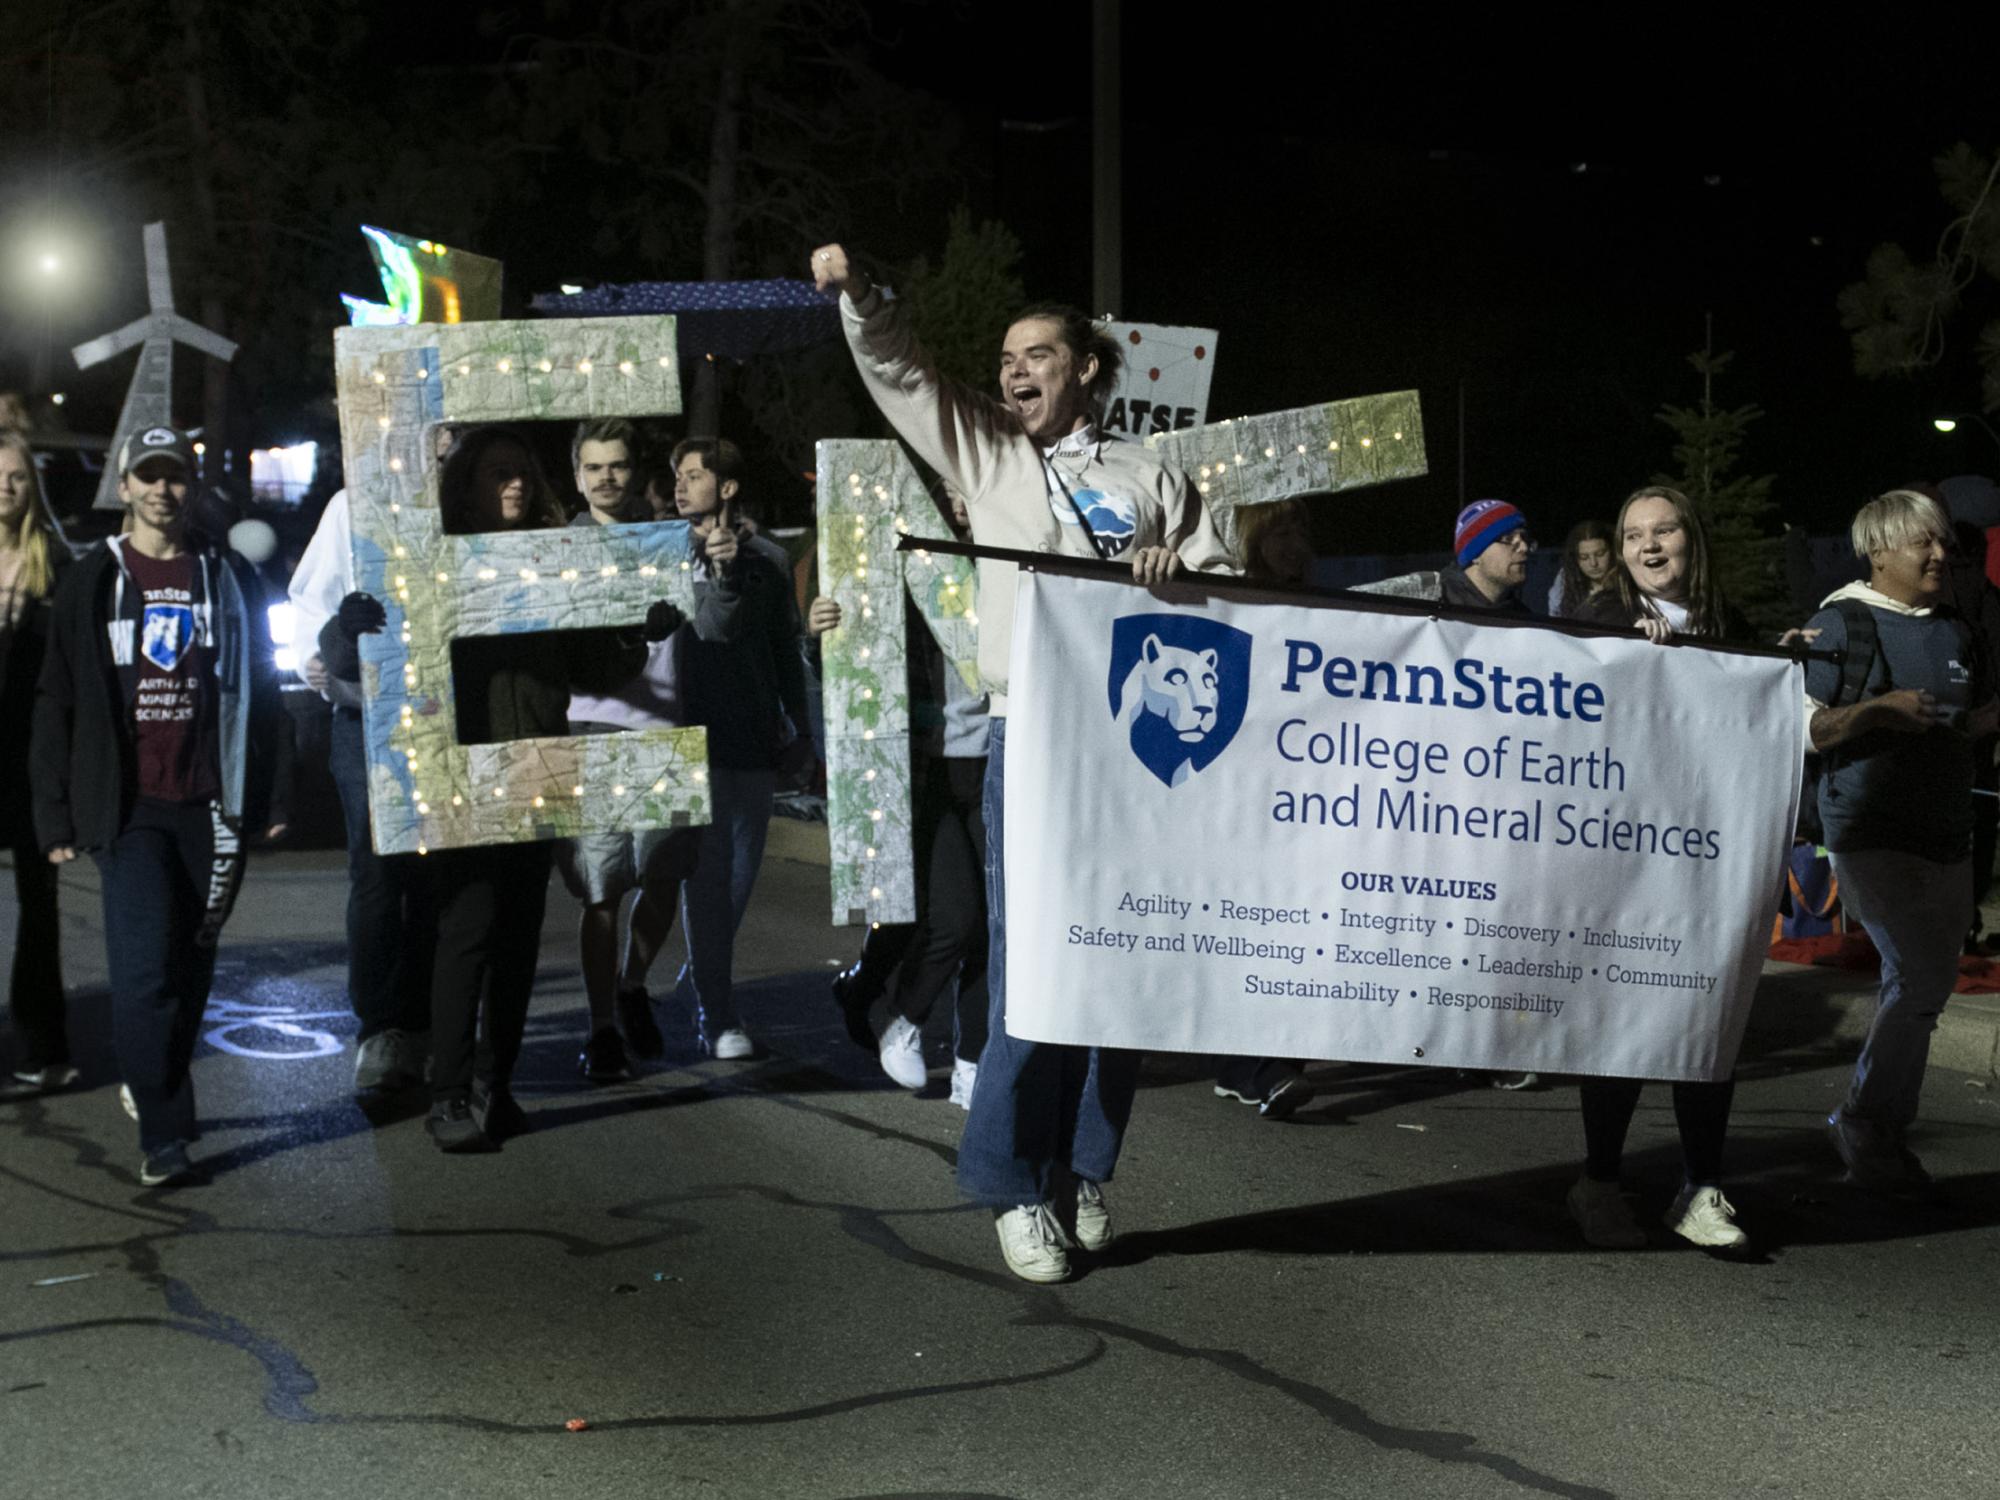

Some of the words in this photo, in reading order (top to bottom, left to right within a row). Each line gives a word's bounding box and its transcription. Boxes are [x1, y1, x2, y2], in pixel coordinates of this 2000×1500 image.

[1280, 639, 1605, 722] PennState
[1276, 718, 1449, 783] College
[1463, 735, 1511, 779] of
[1520, 740, 1626, 792] Earth
[1272, 783, 1360, 828] and
[1376, 787, 1542, 843] Mineral
[1555, 803, 1721, 860] Sciences
[1341, 871, 1395, 893] OUR
[1401, 876, 1497, 901] VALUES
[1118, 891, 1192, 920] Agility
[1219, 899, 1311, 925] Respect
[1339, 907, 1437, 937] Integrity
[1464, 917, 1561, 947] Discovery
[1583, 927, 1683, 957] Inclusivity
[1068, 925, 1139, 953] Safety
[1144, 933, 1186, 953] and
[1192, 933, 1306, 964] Wellbeing
[1335, 943, 1452, 970] Excellence
[1478, 954, 1584, 984] Leadership
[1606, 963, 1718, 993] Community
[1244, 974, 1400, 1007] Sustainability
[1427, 986, 1565, 1018] Responsibility
